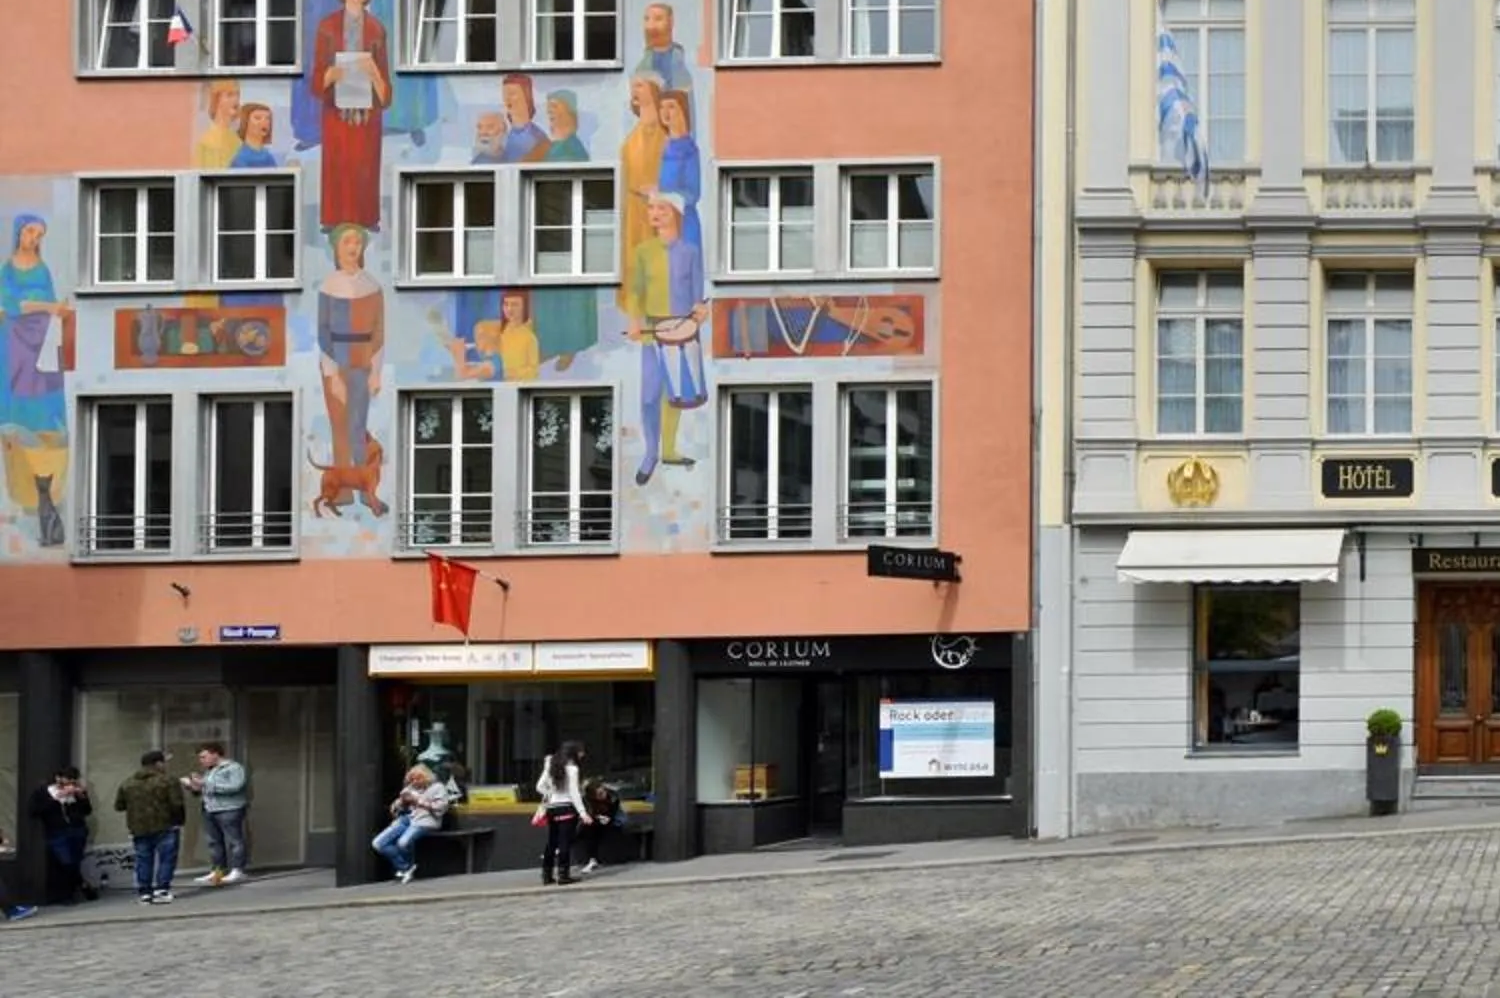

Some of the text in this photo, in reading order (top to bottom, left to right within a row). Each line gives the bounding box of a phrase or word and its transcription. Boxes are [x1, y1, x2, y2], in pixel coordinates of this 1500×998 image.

[883, 551, 945, 570] CORIUM
[727, 641, 831, 659] CORIUM
[889, 709, 920, 722] Rock
[923, 711, 954, 721] oder
